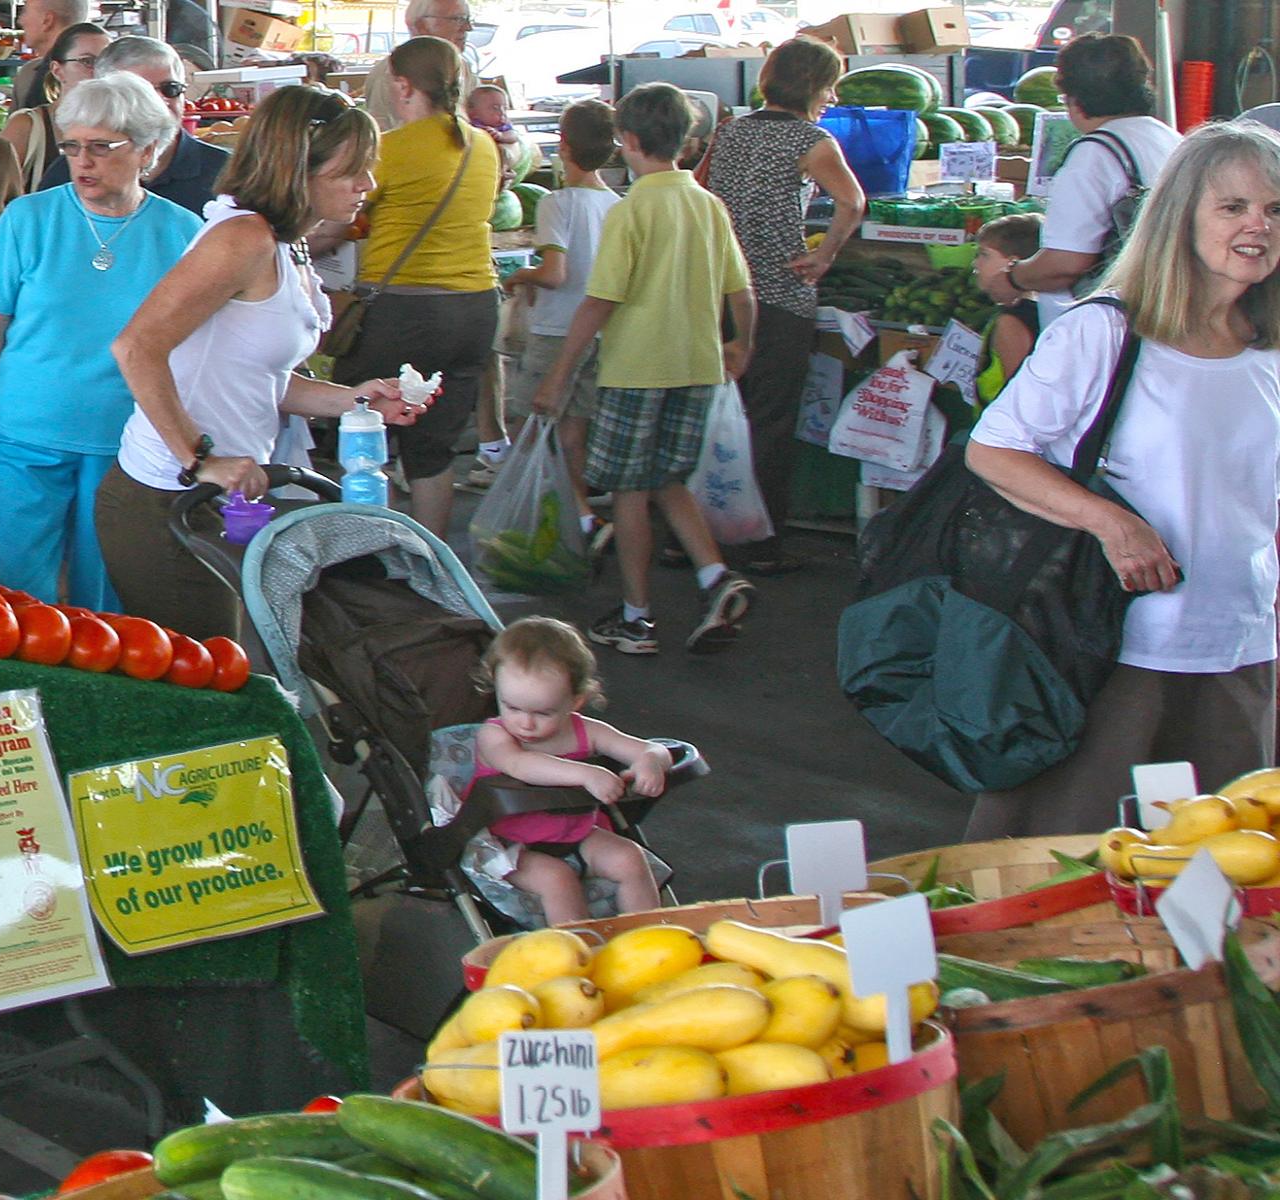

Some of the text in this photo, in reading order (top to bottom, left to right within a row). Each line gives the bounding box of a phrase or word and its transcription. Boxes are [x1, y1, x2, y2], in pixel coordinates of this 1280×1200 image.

[13, 778, 39, 794] Here
[134, 763, 188, 804] NC
[179, 756, 263, 787] AGRICULTURE
[104, 821, 274, 879] We grow 100%
[116, 862, 284, 916] of our produce.
